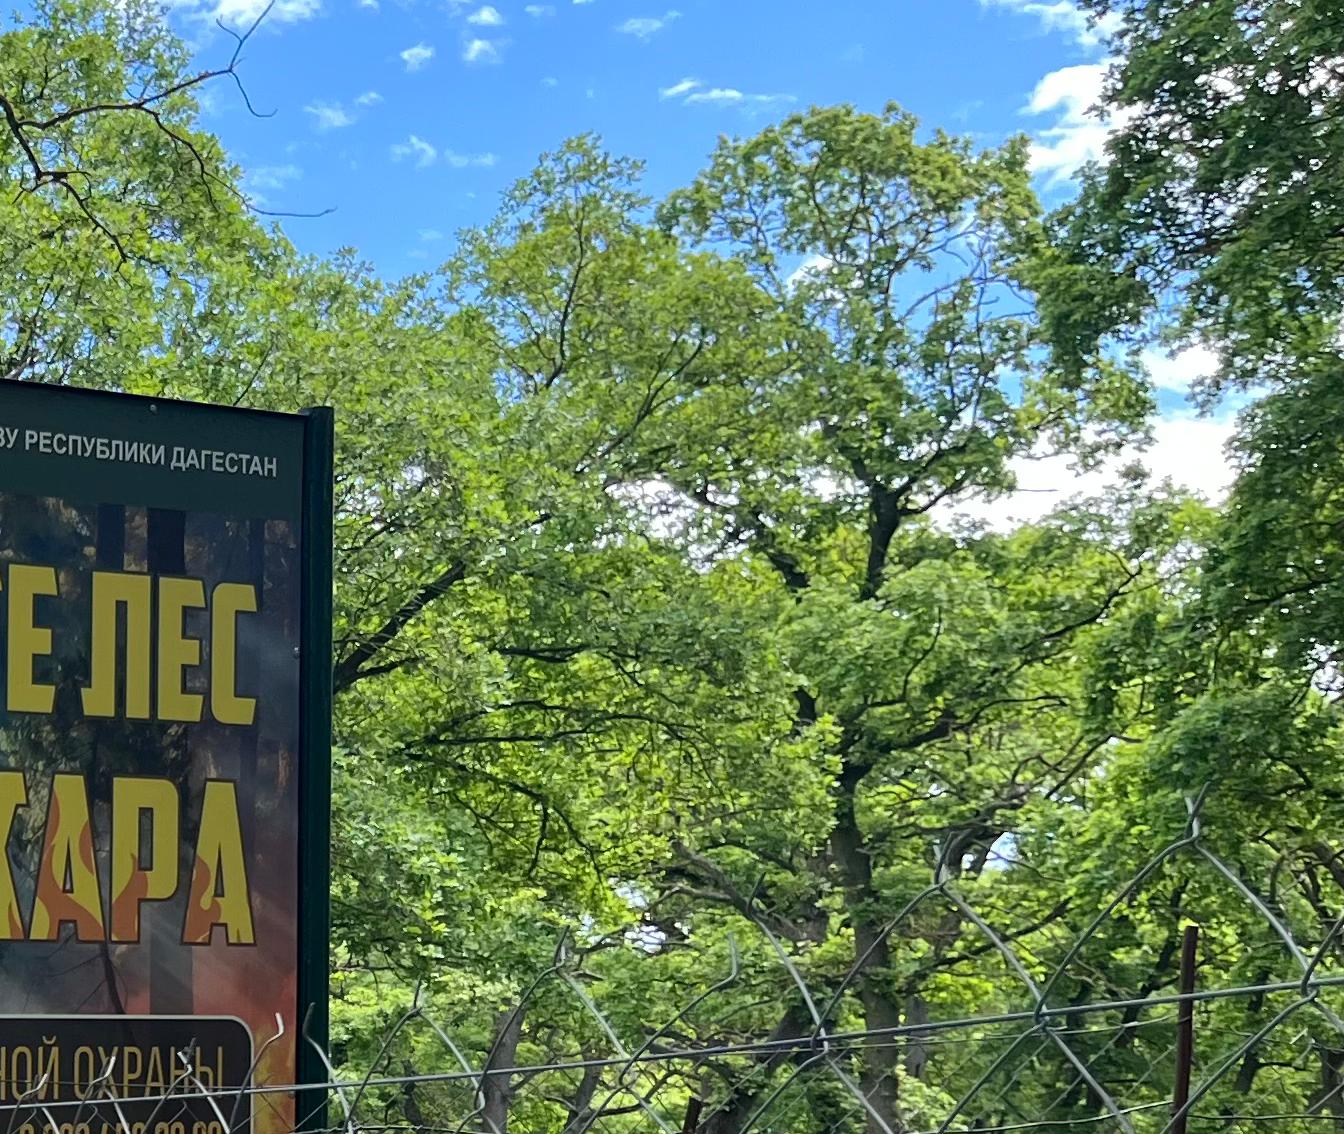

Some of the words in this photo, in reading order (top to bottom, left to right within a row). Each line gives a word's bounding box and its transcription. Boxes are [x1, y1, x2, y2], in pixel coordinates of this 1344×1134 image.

[25, 430, 165, 466] РЕСПУБЛИКИ
[170, 446, 277, 478] ДАГЕСТАН
[81, 572, 258, 726] ЛЕС
[73, 1046, 222, 1100] ОХРАНЫ
